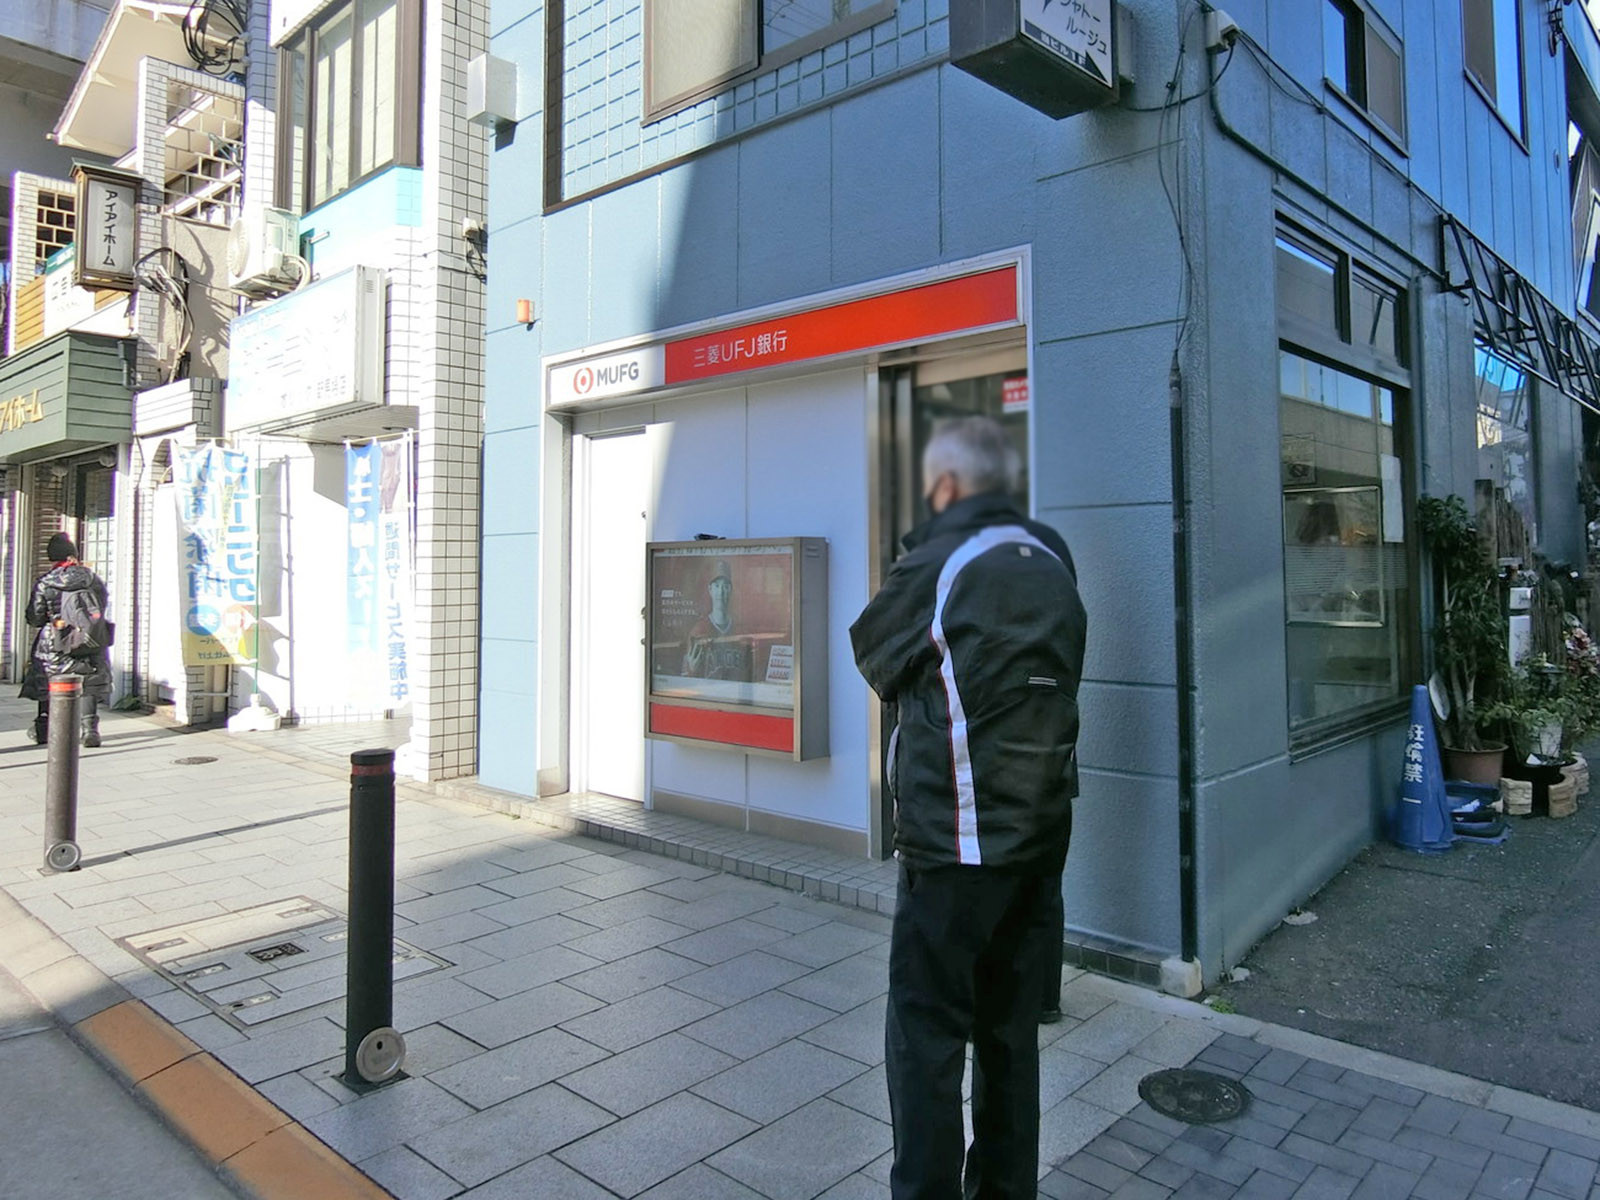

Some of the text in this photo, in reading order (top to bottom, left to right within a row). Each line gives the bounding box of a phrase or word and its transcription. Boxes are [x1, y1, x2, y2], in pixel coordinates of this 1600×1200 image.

[1066, 16, 1107, 56] ルージュ
[102, 189, 118, 267] アイアイホーム
[693, 330, 788, 368] 三菱UFJ銀行
[597, 361, 639, 387] MUFG
